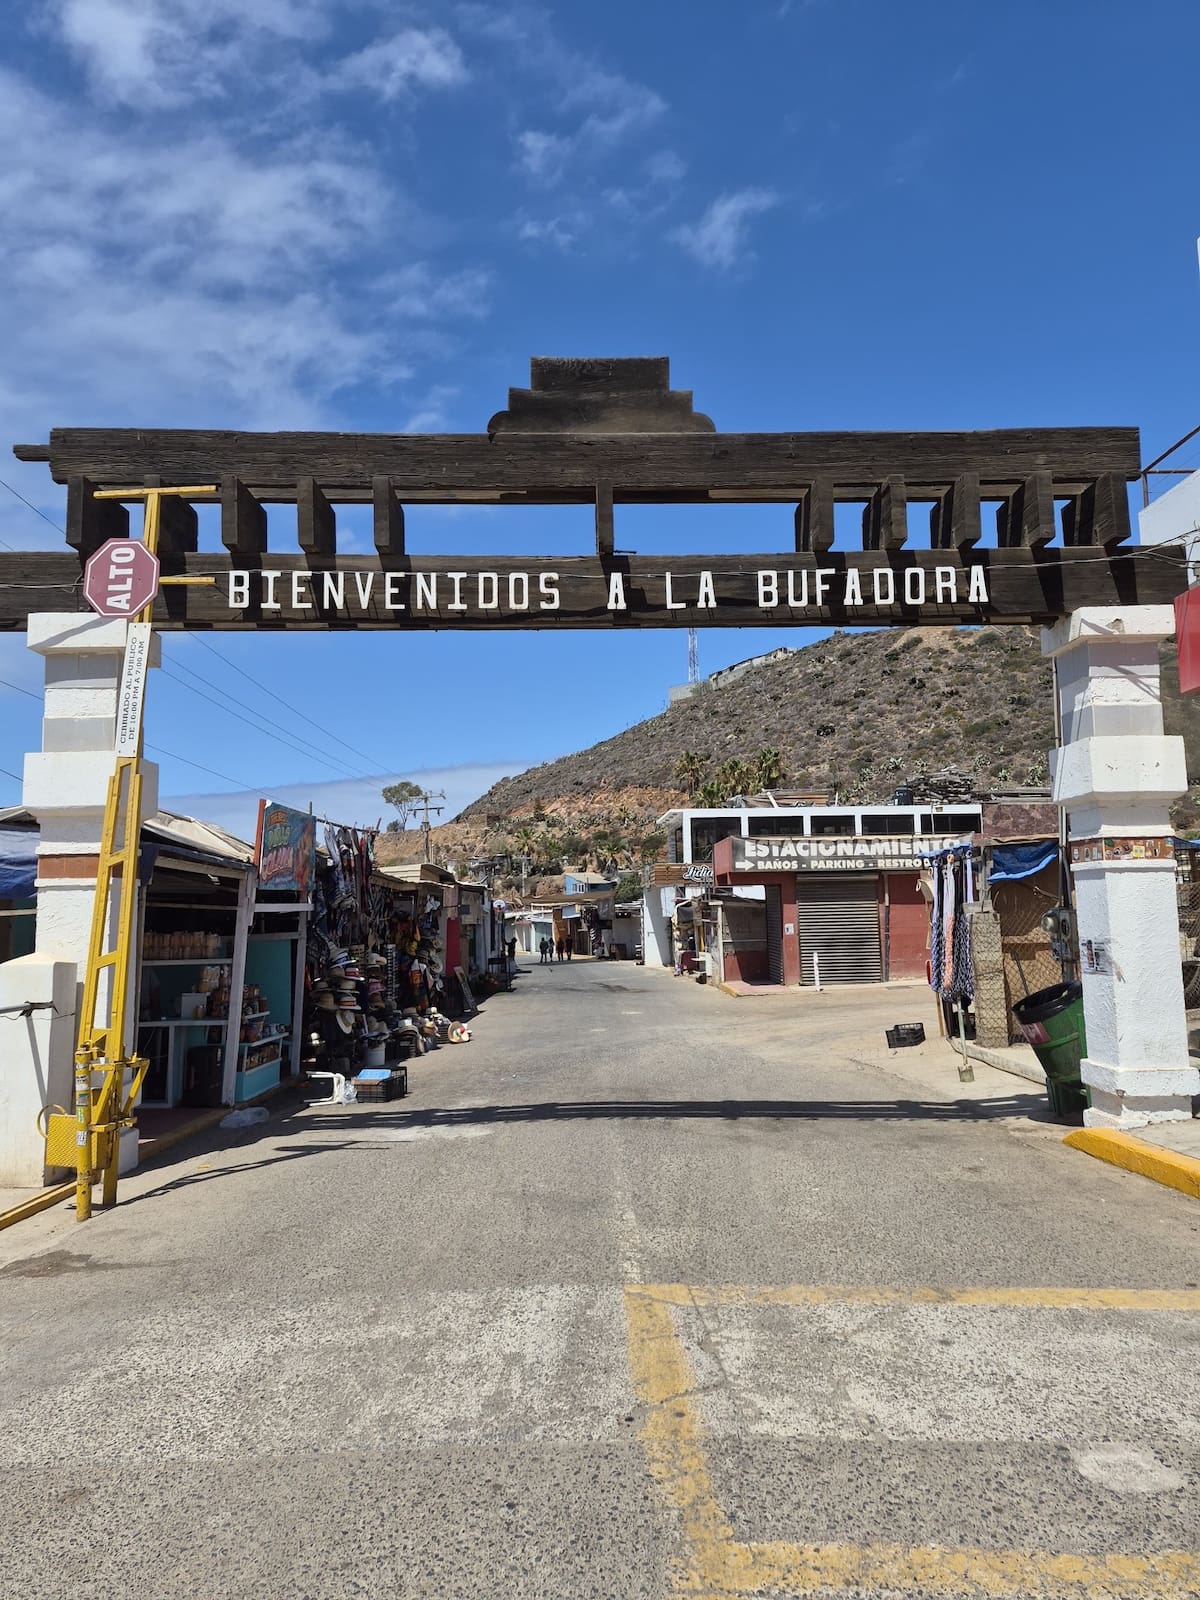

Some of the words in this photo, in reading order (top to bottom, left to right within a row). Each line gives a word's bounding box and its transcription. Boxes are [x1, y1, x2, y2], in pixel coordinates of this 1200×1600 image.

[106, 547, 136, 610] ALTO
[229, 570, 560, 610] BIENVENIDOS
[607, 572, 627, 610] A
[665, 571, 717, 609] LA
[758, 565, 989, 608] BUFADORA
[127, 637, 137, 677] PUBLICO
[138, 641, 144, 655] AM
[126, 679, 132, 690] AL
[132, 686, 139, 699] PM
[120, 693, 131, 743] CERRADO
[130, 701, 138, 724] 10:00
[128, 728, 135, 739] DE
[745, 839, 960, 857] ESTACIONAMIENTO
[757, 859, 798, 869] BAÑOS
[810, 859, 865, 869] PARKING
